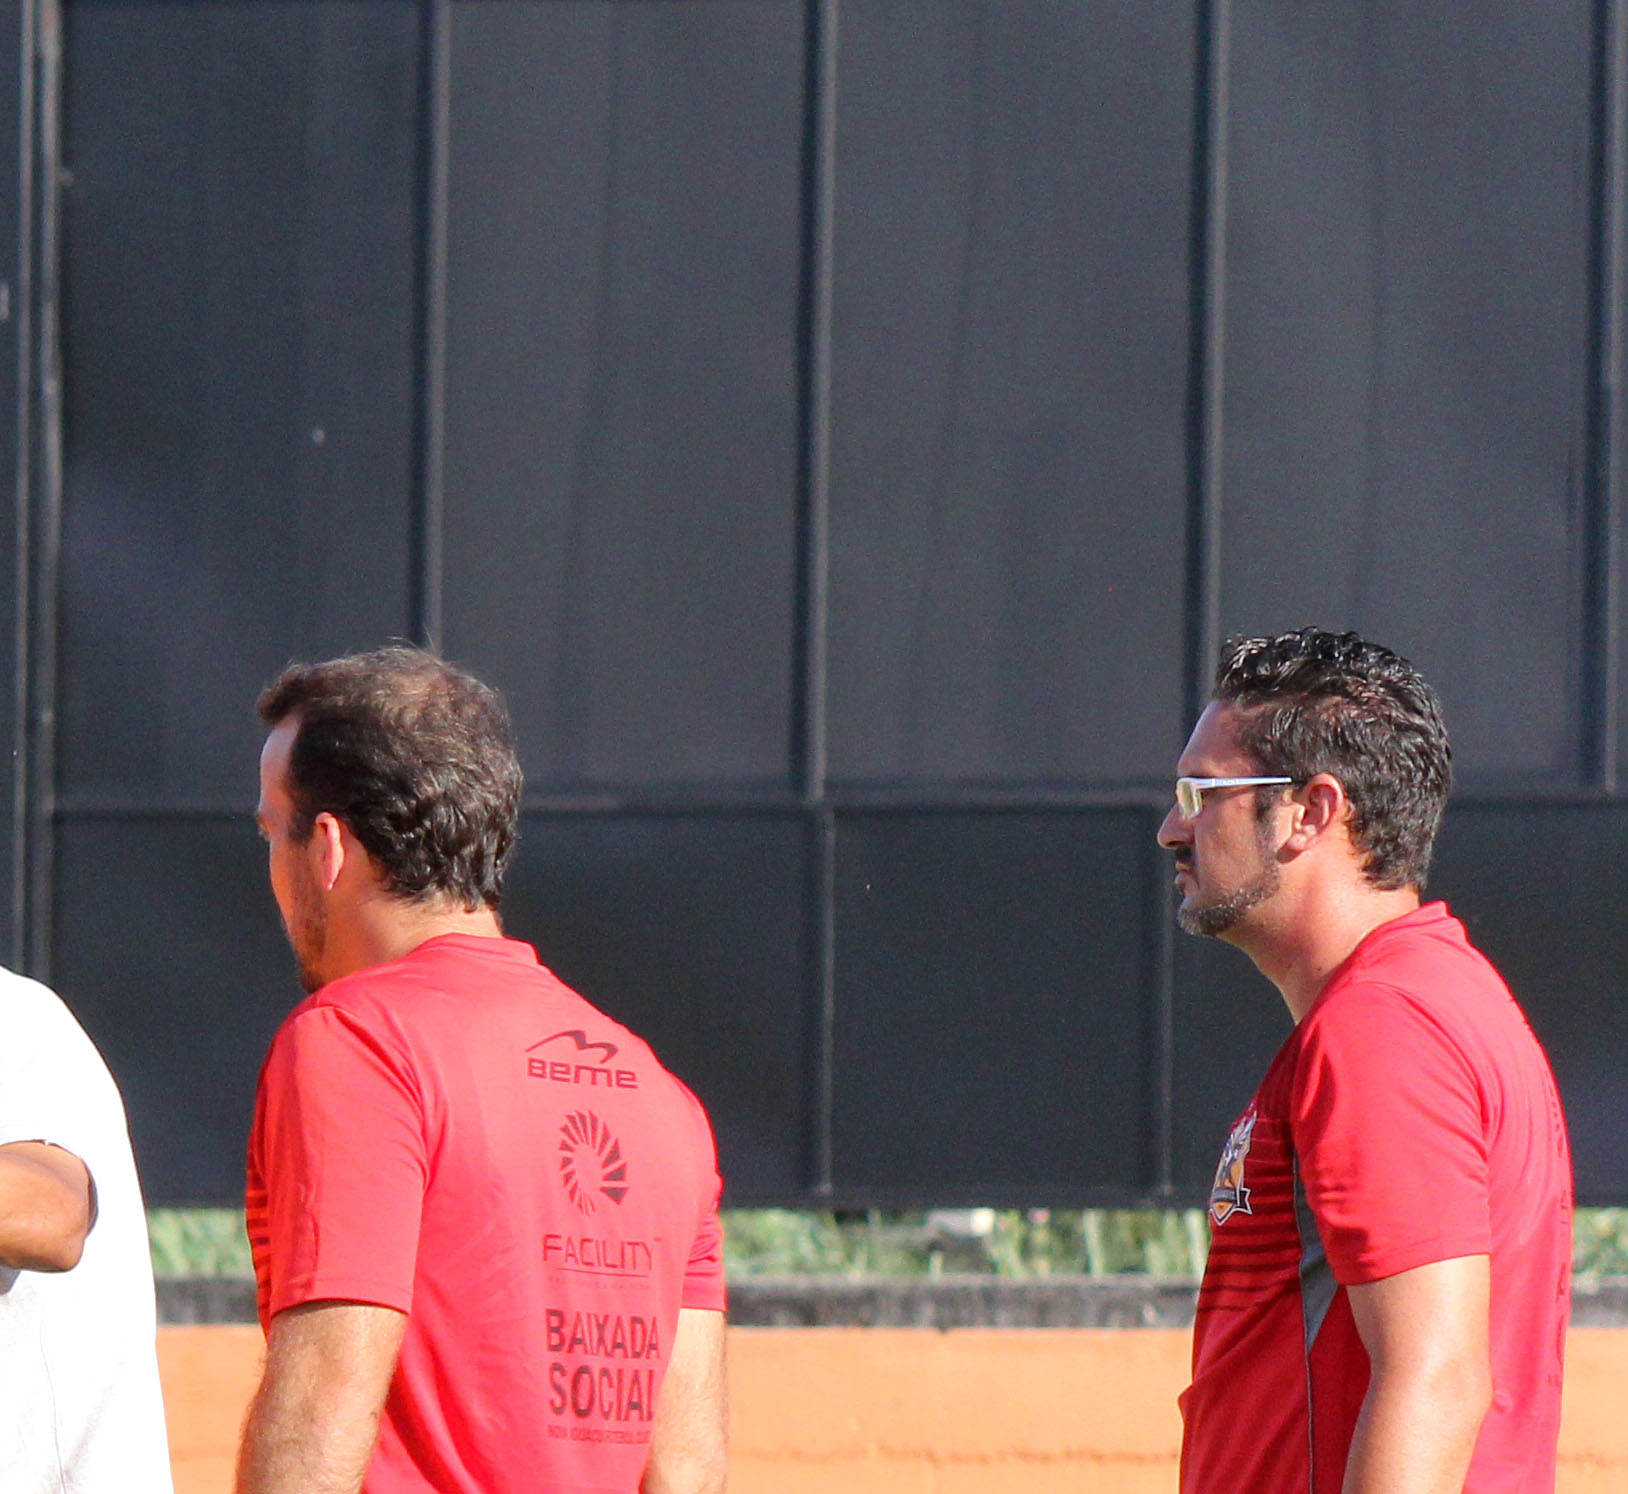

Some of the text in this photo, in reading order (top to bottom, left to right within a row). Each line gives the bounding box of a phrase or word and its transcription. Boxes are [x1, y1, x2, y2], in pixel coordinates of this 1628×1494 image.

[542, 1233, 653, 1271] FACILITY
[545, 1308, 661, 1360] BAIXADA
[548, 1362, 655, 1423] SOCIAL
